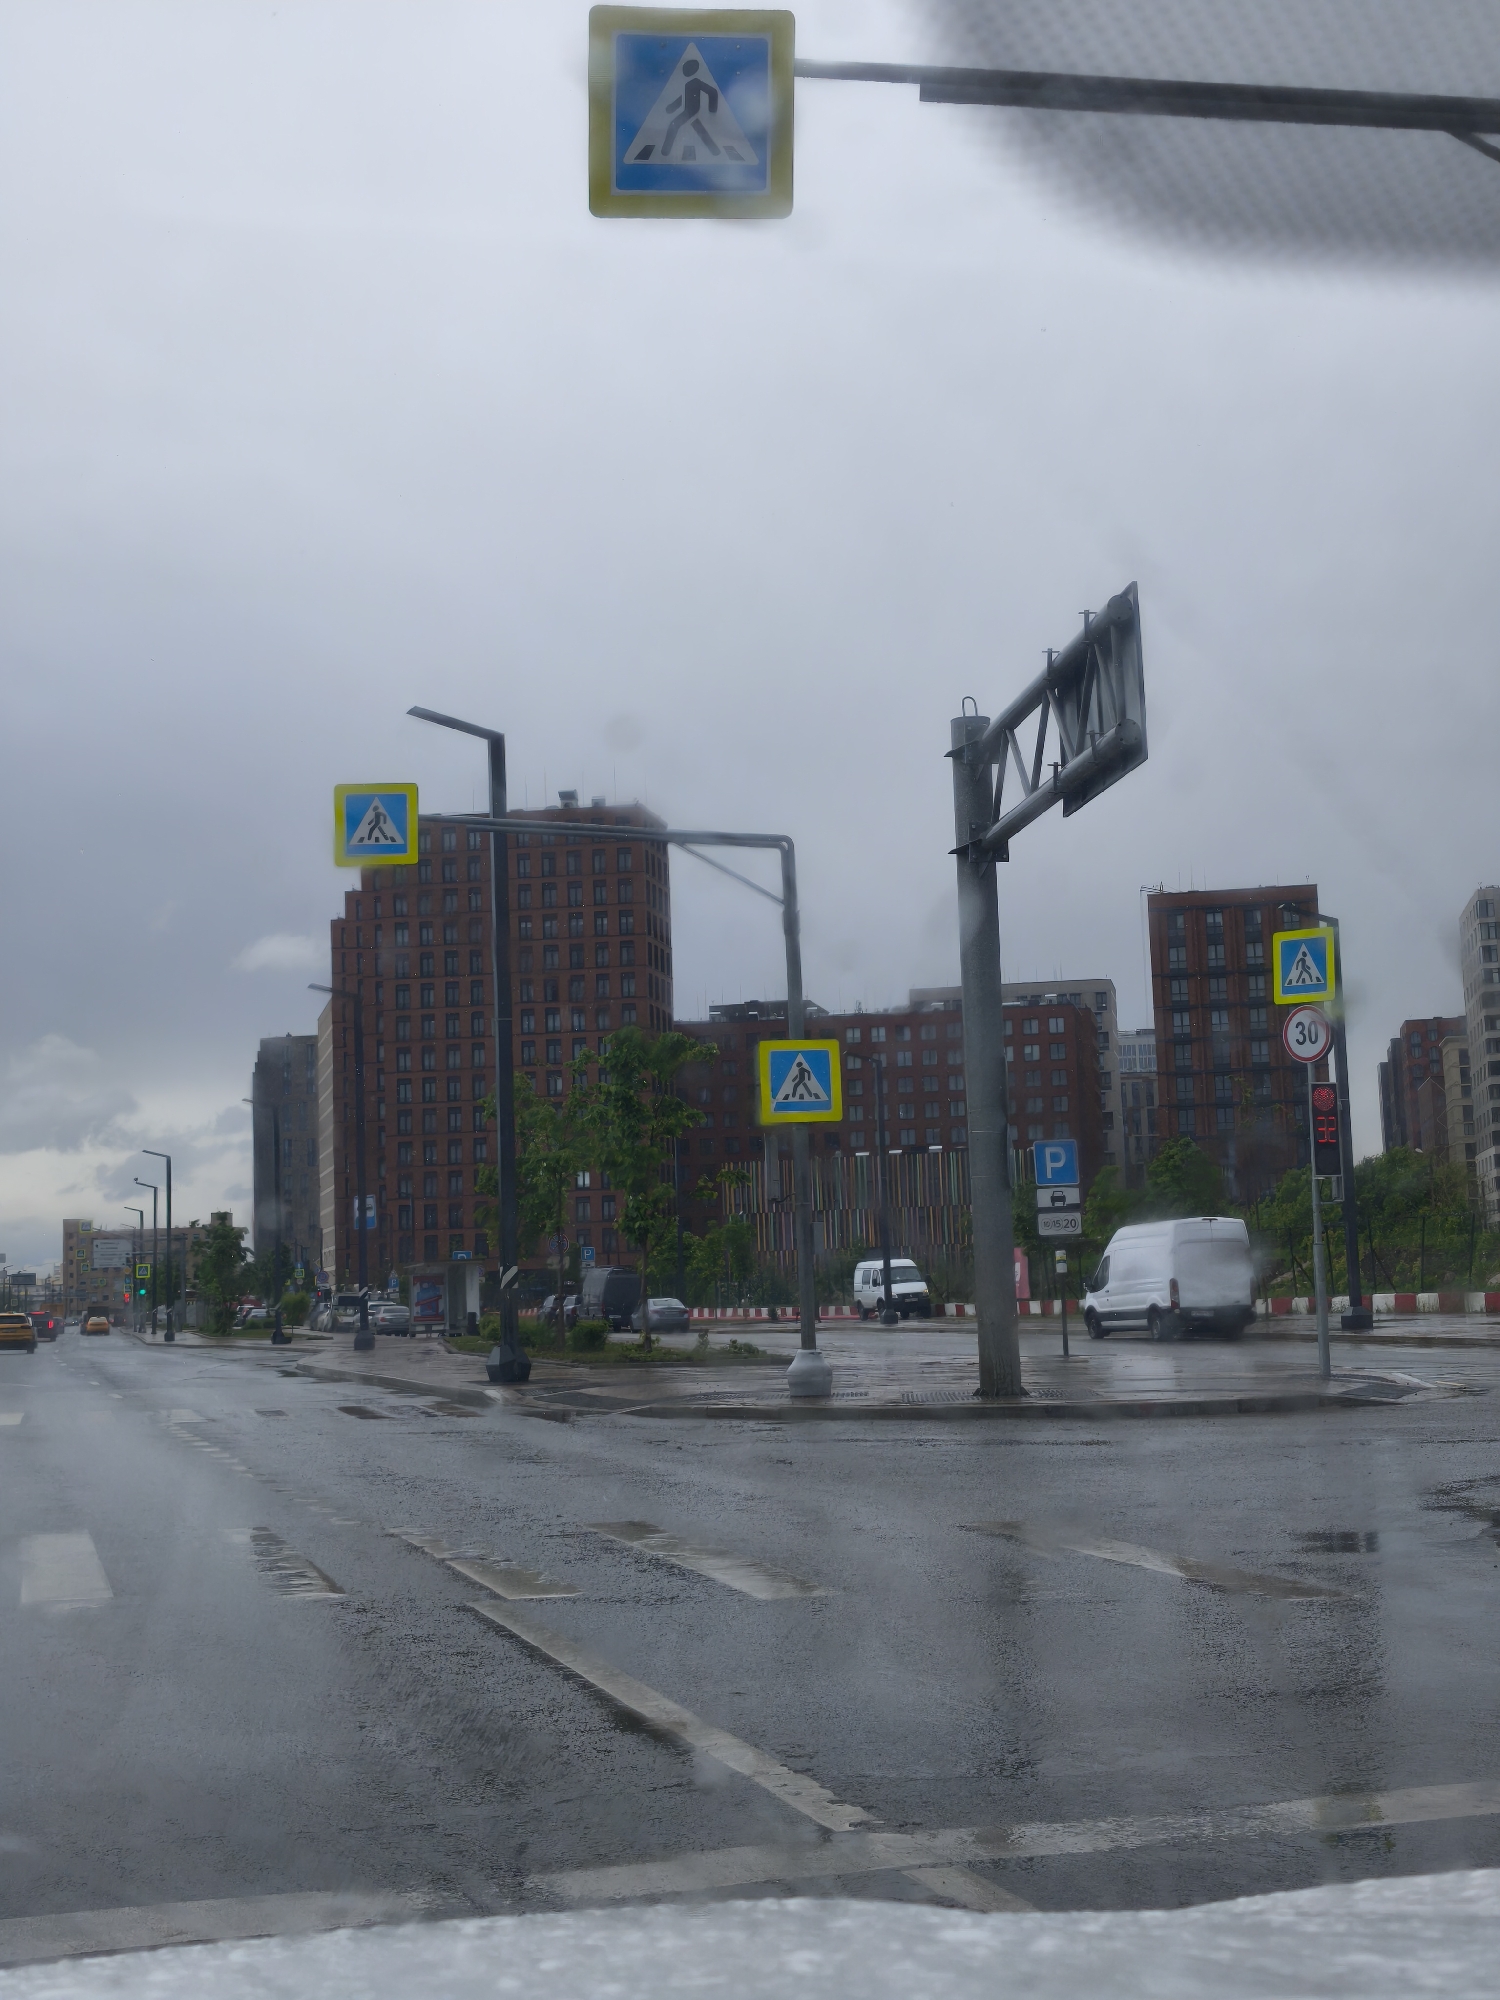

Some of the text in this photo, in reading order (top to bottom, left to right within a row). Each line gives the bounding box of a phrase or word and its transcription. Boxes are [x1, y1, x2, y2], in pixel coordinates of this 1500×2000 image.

[1295, 1021, 1319, 1045] 30
[1316, 1116, 1337, 1143] 32
[1045, 1146, 1067, 1179] P
[1052, 1220, 1061, 1228] 15
[1063, 1218, 1077, 1229] 20
[584, 1249, 592, 1260] P
